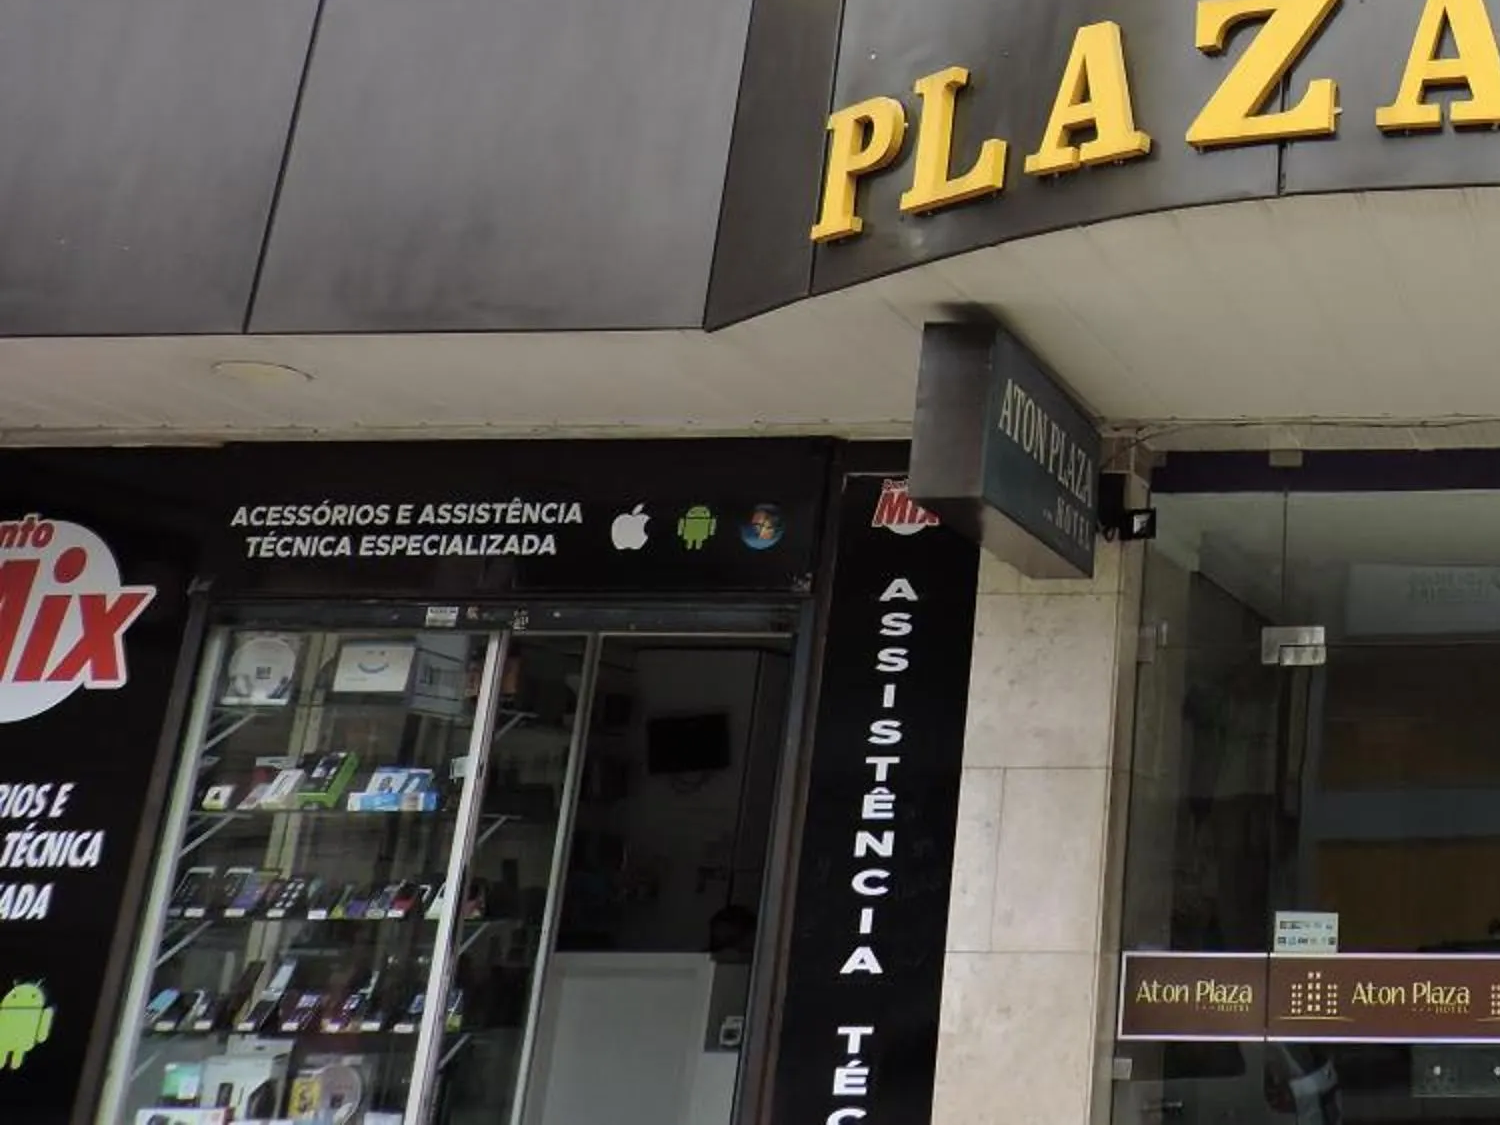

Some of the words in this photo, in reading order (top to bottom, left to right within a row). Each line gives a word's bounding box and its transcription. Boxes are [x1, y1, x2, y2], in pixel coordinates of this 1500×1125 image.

[999, 378, 1048, 465] ATON
[1048, 420, 1093, 508] PLAZA
[230, 499, 392, 527] ACESSÓRIOS
[396, 504, 415, 525] E
[418, 496, 584, 525] ASSISTÊNCIA
[246, 530, 352, 558] TÉCNICA
[358, 533, 557, 557] ESPECIALIZADA
[839, 577, 919, 975] ASSISTÊNCIA
[48, 782, 77, 818] E
[0, 821, 105, 868] TÉCNICA
[0, 882, 55, 920] ADA
[1136, 979, 1189, 1004] Aton
[1195, 978, 1254, 1004] Plaza
[1351, 981, 1406, 1006] Aton
[1412, 979, 1471, 1006] Plaza
